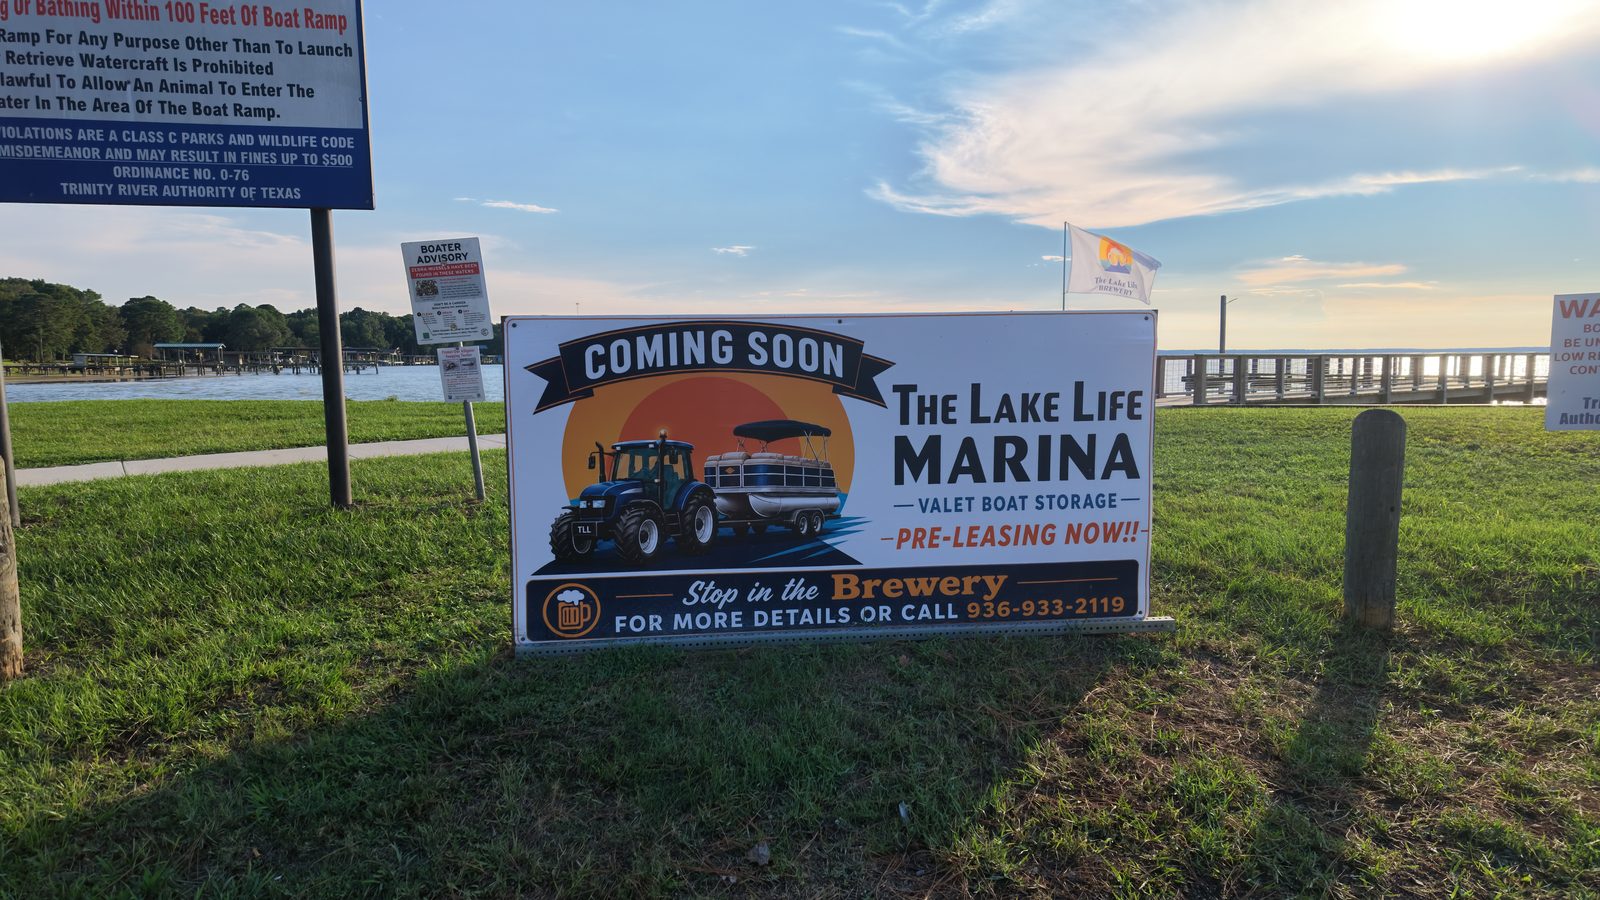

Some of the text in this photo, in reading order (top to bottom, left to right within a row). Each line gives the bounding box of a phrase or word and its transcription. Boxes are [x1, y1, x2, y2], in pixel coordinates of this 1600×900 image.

[14, 0, 30, 15] Or
[36, 0, 100, 24] Bathing
[105, 0, 160, 20] Within
[165, 1, 194, 23] 100
[200, 2, 236, 25] Feet
[241, 4, 258, 26] Of
[263, 6, 300, 28] Boat
[304, 8, 347, 35] Ramp
[46, 29, 72, 44] For
[78, 30, 108, 50] Any
[113, 32, 180, 52] Purpose
[185, 36, 228, 52] Other
[232, 38, 270, 54] Than
[276, 40, 293, 54] To
[298, 41, 352, 57] Launch
[6, 50, 274, 76] Retrieve Watercraft Is Prohibited
[56, 74, 76, 88] To
[82, 75, 128, 91] Allow
[134, 78, 153, 92] An
[159, 79, 213, 94] Animal
[218, 81, 236, 95] To
[242, 82, 282, 97] Enter
[286, 84, 314, 98] The
[35, 96, 50, 110] In
[56, 96, 86, 111] The
[93, 98, 130, 113] Area
[136, 100, 152, 114] Of
[158, 101, 187, 115] The
[192, 102, 228, 116] Boat
[234, 103, 280, 121] Ramp.
[0, 126, 354, 148] IOLATIONS ARE A CLASS C PARKS AND WILDLIFE CODE
[0, 145, 353, 166] MISDEMEANOR AND MAY RESULT IN FINES UP TO $500
[113, 166, 189, 180] ORDINANCE
[194, 168, 216, 180] NO.
[60, 182, 301, 199] TRINITY RIVER AUTHORITY OF TEXAS
[417, 252, 468, 264] ADVISORY
[421, 243, 461, 253] BOATER
[1564, 338, 1581, 347] BE
[584, 330, 844, 380] COMING SOON
[1554, 352, 1584, 361] LOW
[1570, 365, 1600, 374] CON
[894, 433, 1140, 486] MARINA
[918, 493, 1117, 513] VALET BOAT STORAGE
[896, 521, 1140, 550] PRE-LEASING NOW!!
[682, 573, 1008, 609] Stop in the Brewery
[615, 596, 1125, 632] FOR MORE DETAILS OR CALL 936-933-2119
